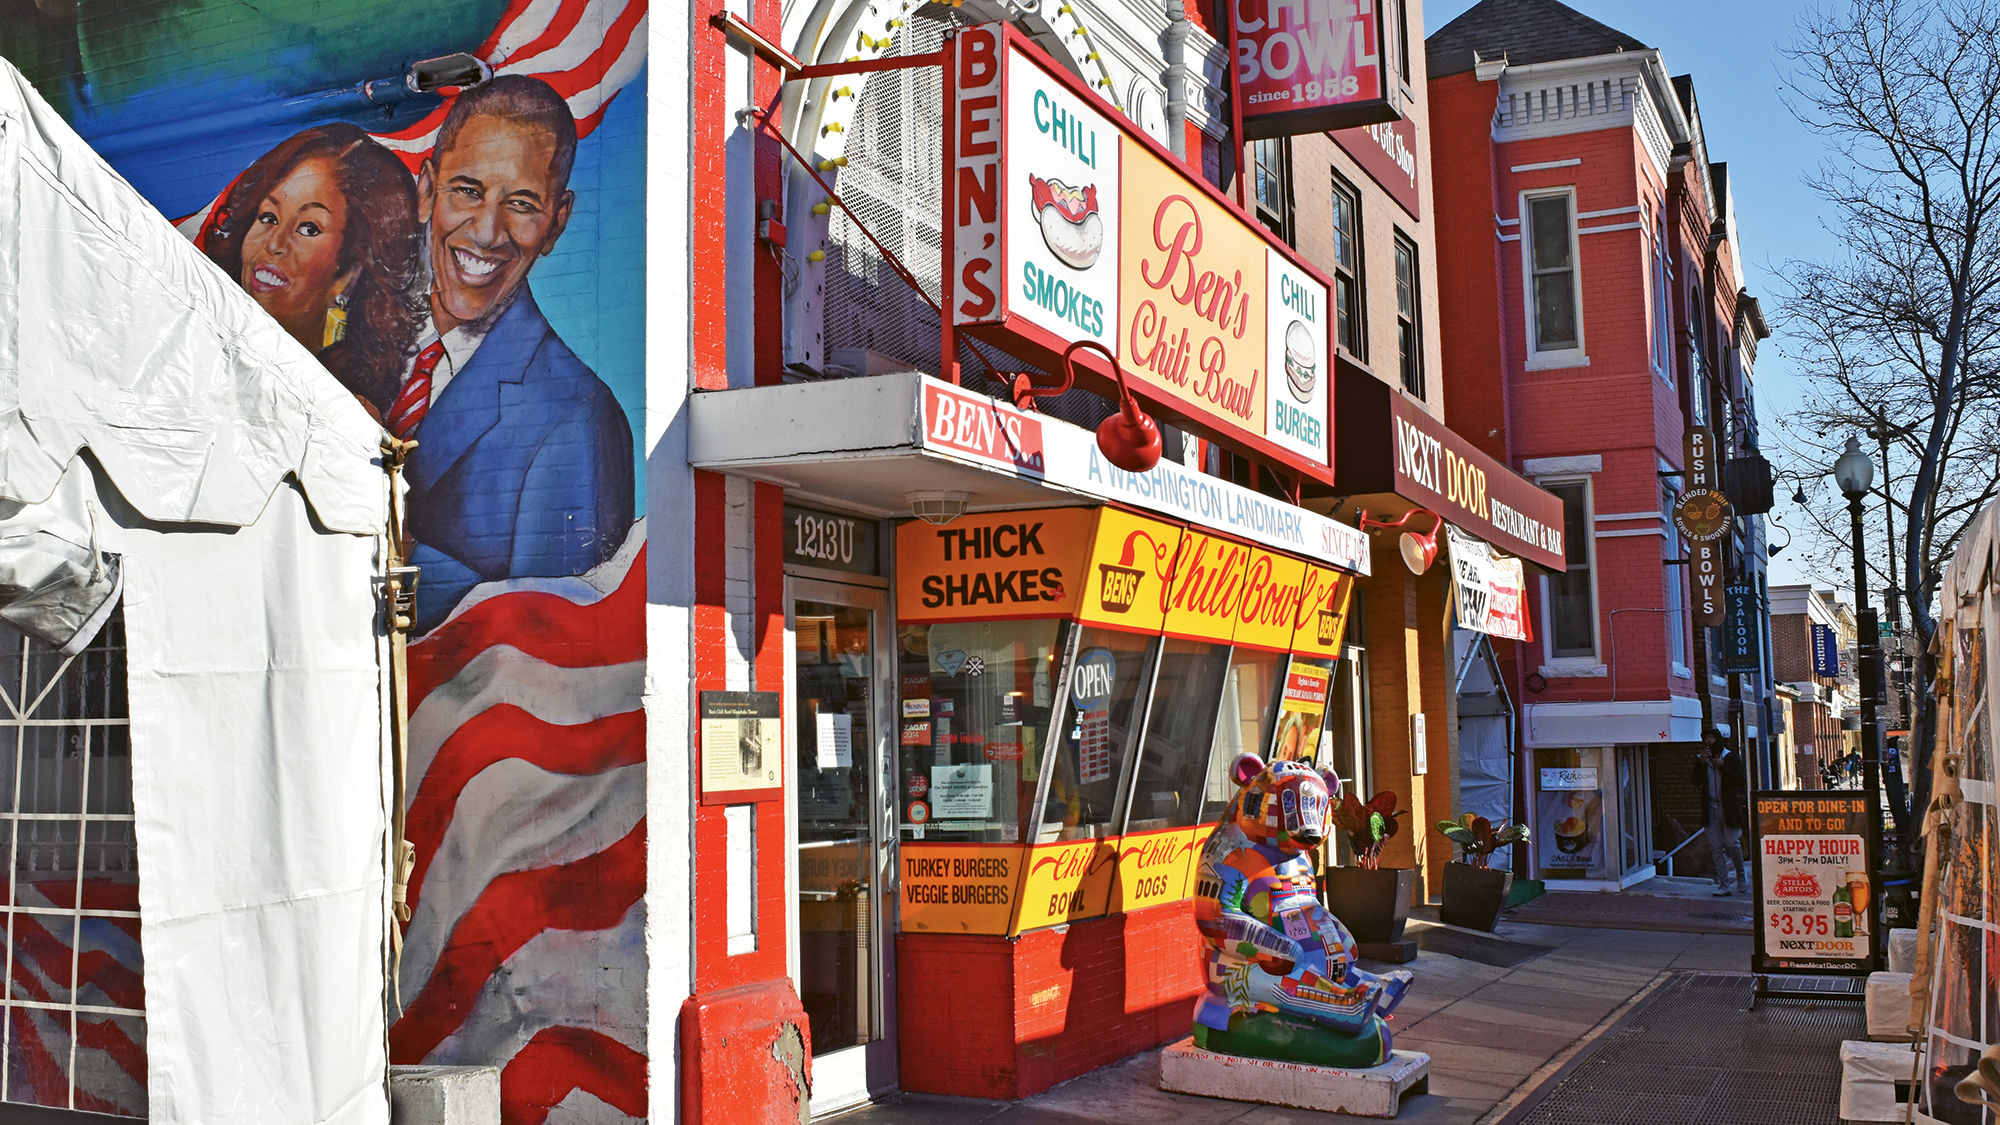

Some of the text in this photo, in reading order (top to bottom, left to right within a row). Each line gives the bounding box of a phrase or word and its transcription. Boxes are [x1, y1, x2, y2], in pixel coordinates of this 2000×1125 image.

[1237, 20, 1380, 84] BOWL
[1249, 75, 1359, 104] since 1958
[1034, 88, 1096, 170] CHILI
[959, 28, 998, 318] BEN'S
[1396, 134, 1415, 189] Shop
[1141, 194, 1250, 340] Ben's
[1023, 261, 1104, 339] SMOKES
[1281, 273, 1316, 324] CHILI
[1130, 299, 1259, 421] Chili Bowl
[1276, 399, 1321, 450] BURGER
[1692, 433, 1706, 485] RUSH
[1088, 443, 1103, 484] A
[1225, 489, 1306, 546] LANDMARK
[1322, 523, 1352, 561] SINCE
[1445, 448, 1489, 521] DOOR
[1491, 497, 1540, 547] RESTAURANT
[1540, 524, 1547, 550] &
[1547, 525, 1563, 556] BAR
[1675, 488, 1729, 510] BLENDED FRUIT
[936, 522, 1045, 561] THICK
[1675, 515, 1731, 542] BOWLS & SMOOTHIES
[921, 567, 1064, 608] SHAKES
[1102, 570, 1137, 606] BEN'S
[1159, 533, 1318, 631] Chili Bowl
[1699, 546, 1715, 614] BOWLS
[1726, 586, 1750, 596] THE
[1736, 597, 1747, 655] SALOON
[1074, 662, 1110, 700] OPEN
[903, 723, 929, 731] ZAGAT
[903, 731, 919, 739] 2014
[1757, 800, 1865, 814] OPEN FOR DINE-IN
[1778, 818, 1803, 831] AND
[1052, 842, 1099, 881] Chili
[1137, 836, 1178, 869] Chili
[1765, 839, 1860, 855] HAPPY HOUR
[1777, 856, 1794, 864] 3PM
[1803, 856, 1819, 865] 7PM
[1820, 855, 1849, 865] DAILY!
[906, 858, 1009, 878] TURKEY BURGERS
[1135, 874, 1168, 899] DOGS
[907, 884, 1009, 905] VEGGIE BURGERS
[1047, 889, 1085, 917] BOWL
[1770, 913, 1828, 936] $3.95
